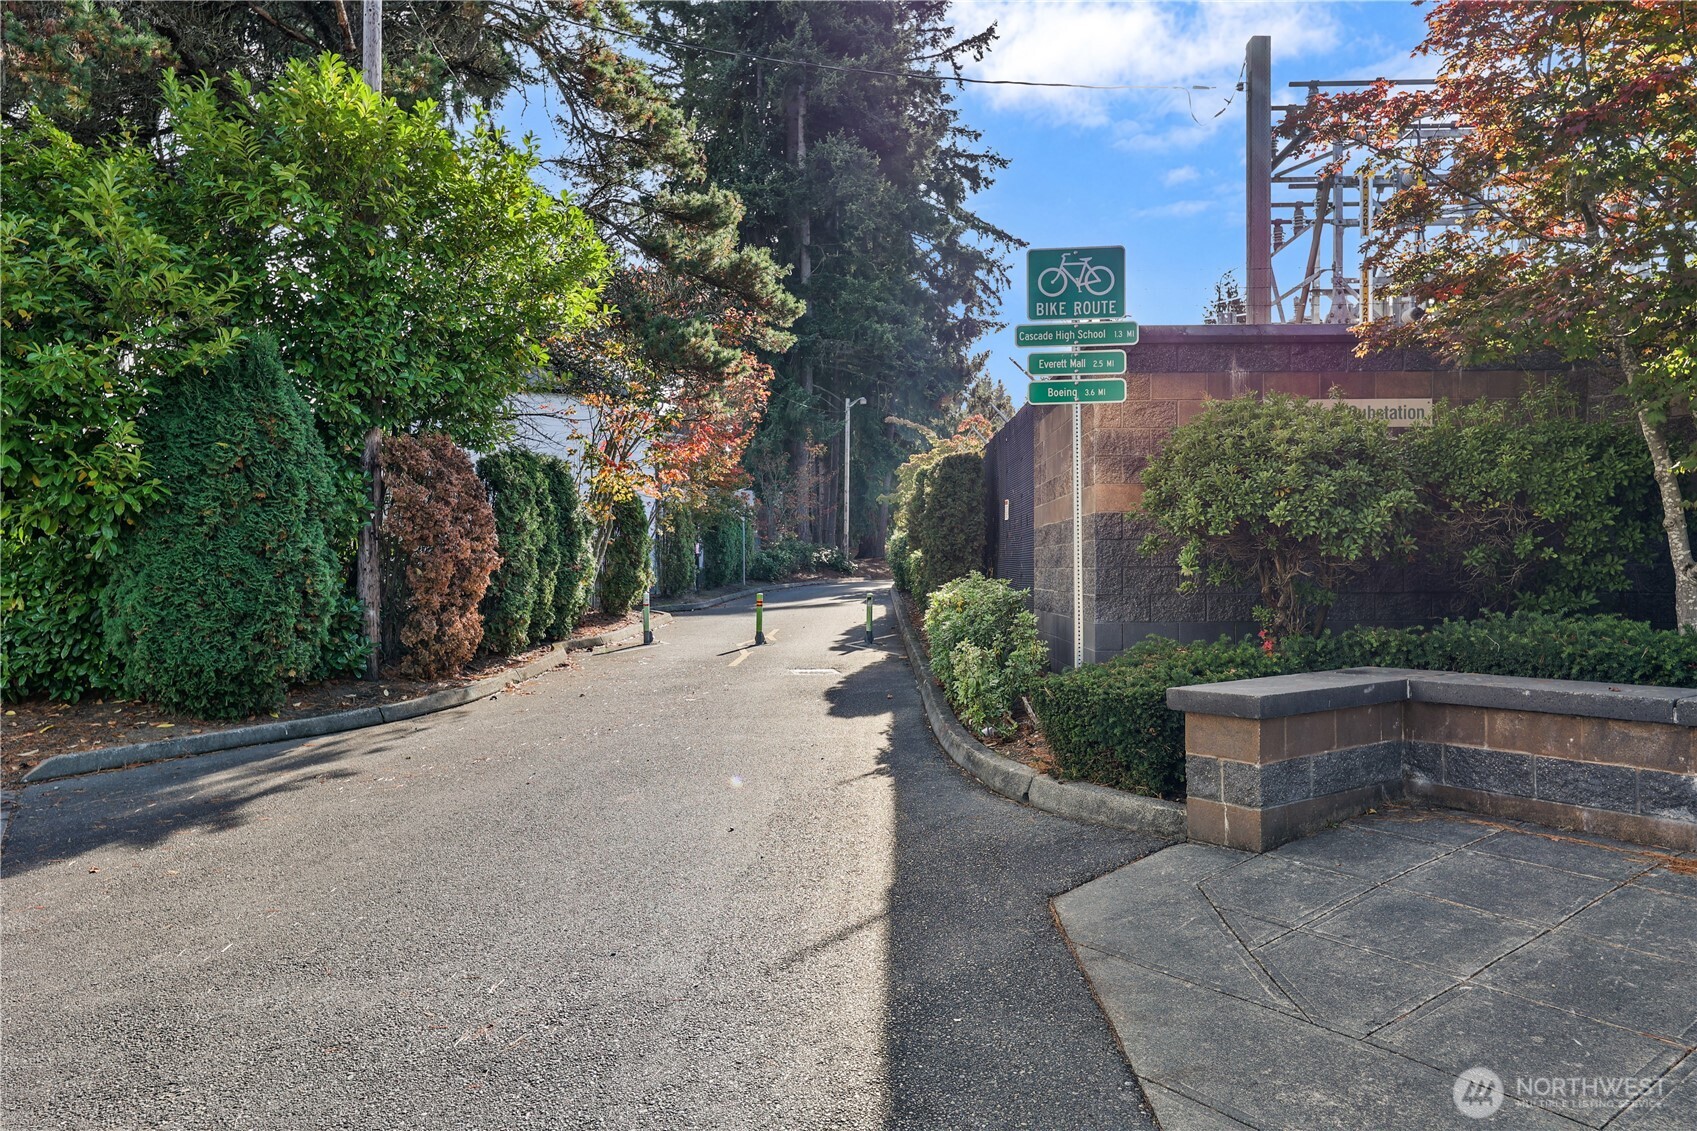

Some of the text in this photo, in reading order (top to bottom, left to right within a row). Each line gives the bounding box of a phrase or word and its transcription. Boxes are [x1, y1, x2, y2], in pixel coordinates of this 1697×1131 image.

[1036, 300, 1117, 316] BIKE ROUTE
[1019, 329, 1135, 342] Cascade High School 1.3 MI
[1038, 359, 1067, 369] Everett
[1069, 358, 1086, 368] Mall
[1092, 360, 1104, 368] 2.5
[1047, 387, 1106, 400] Boeing 3.6 MI
[1349, 405, 1425, 420] bstation
